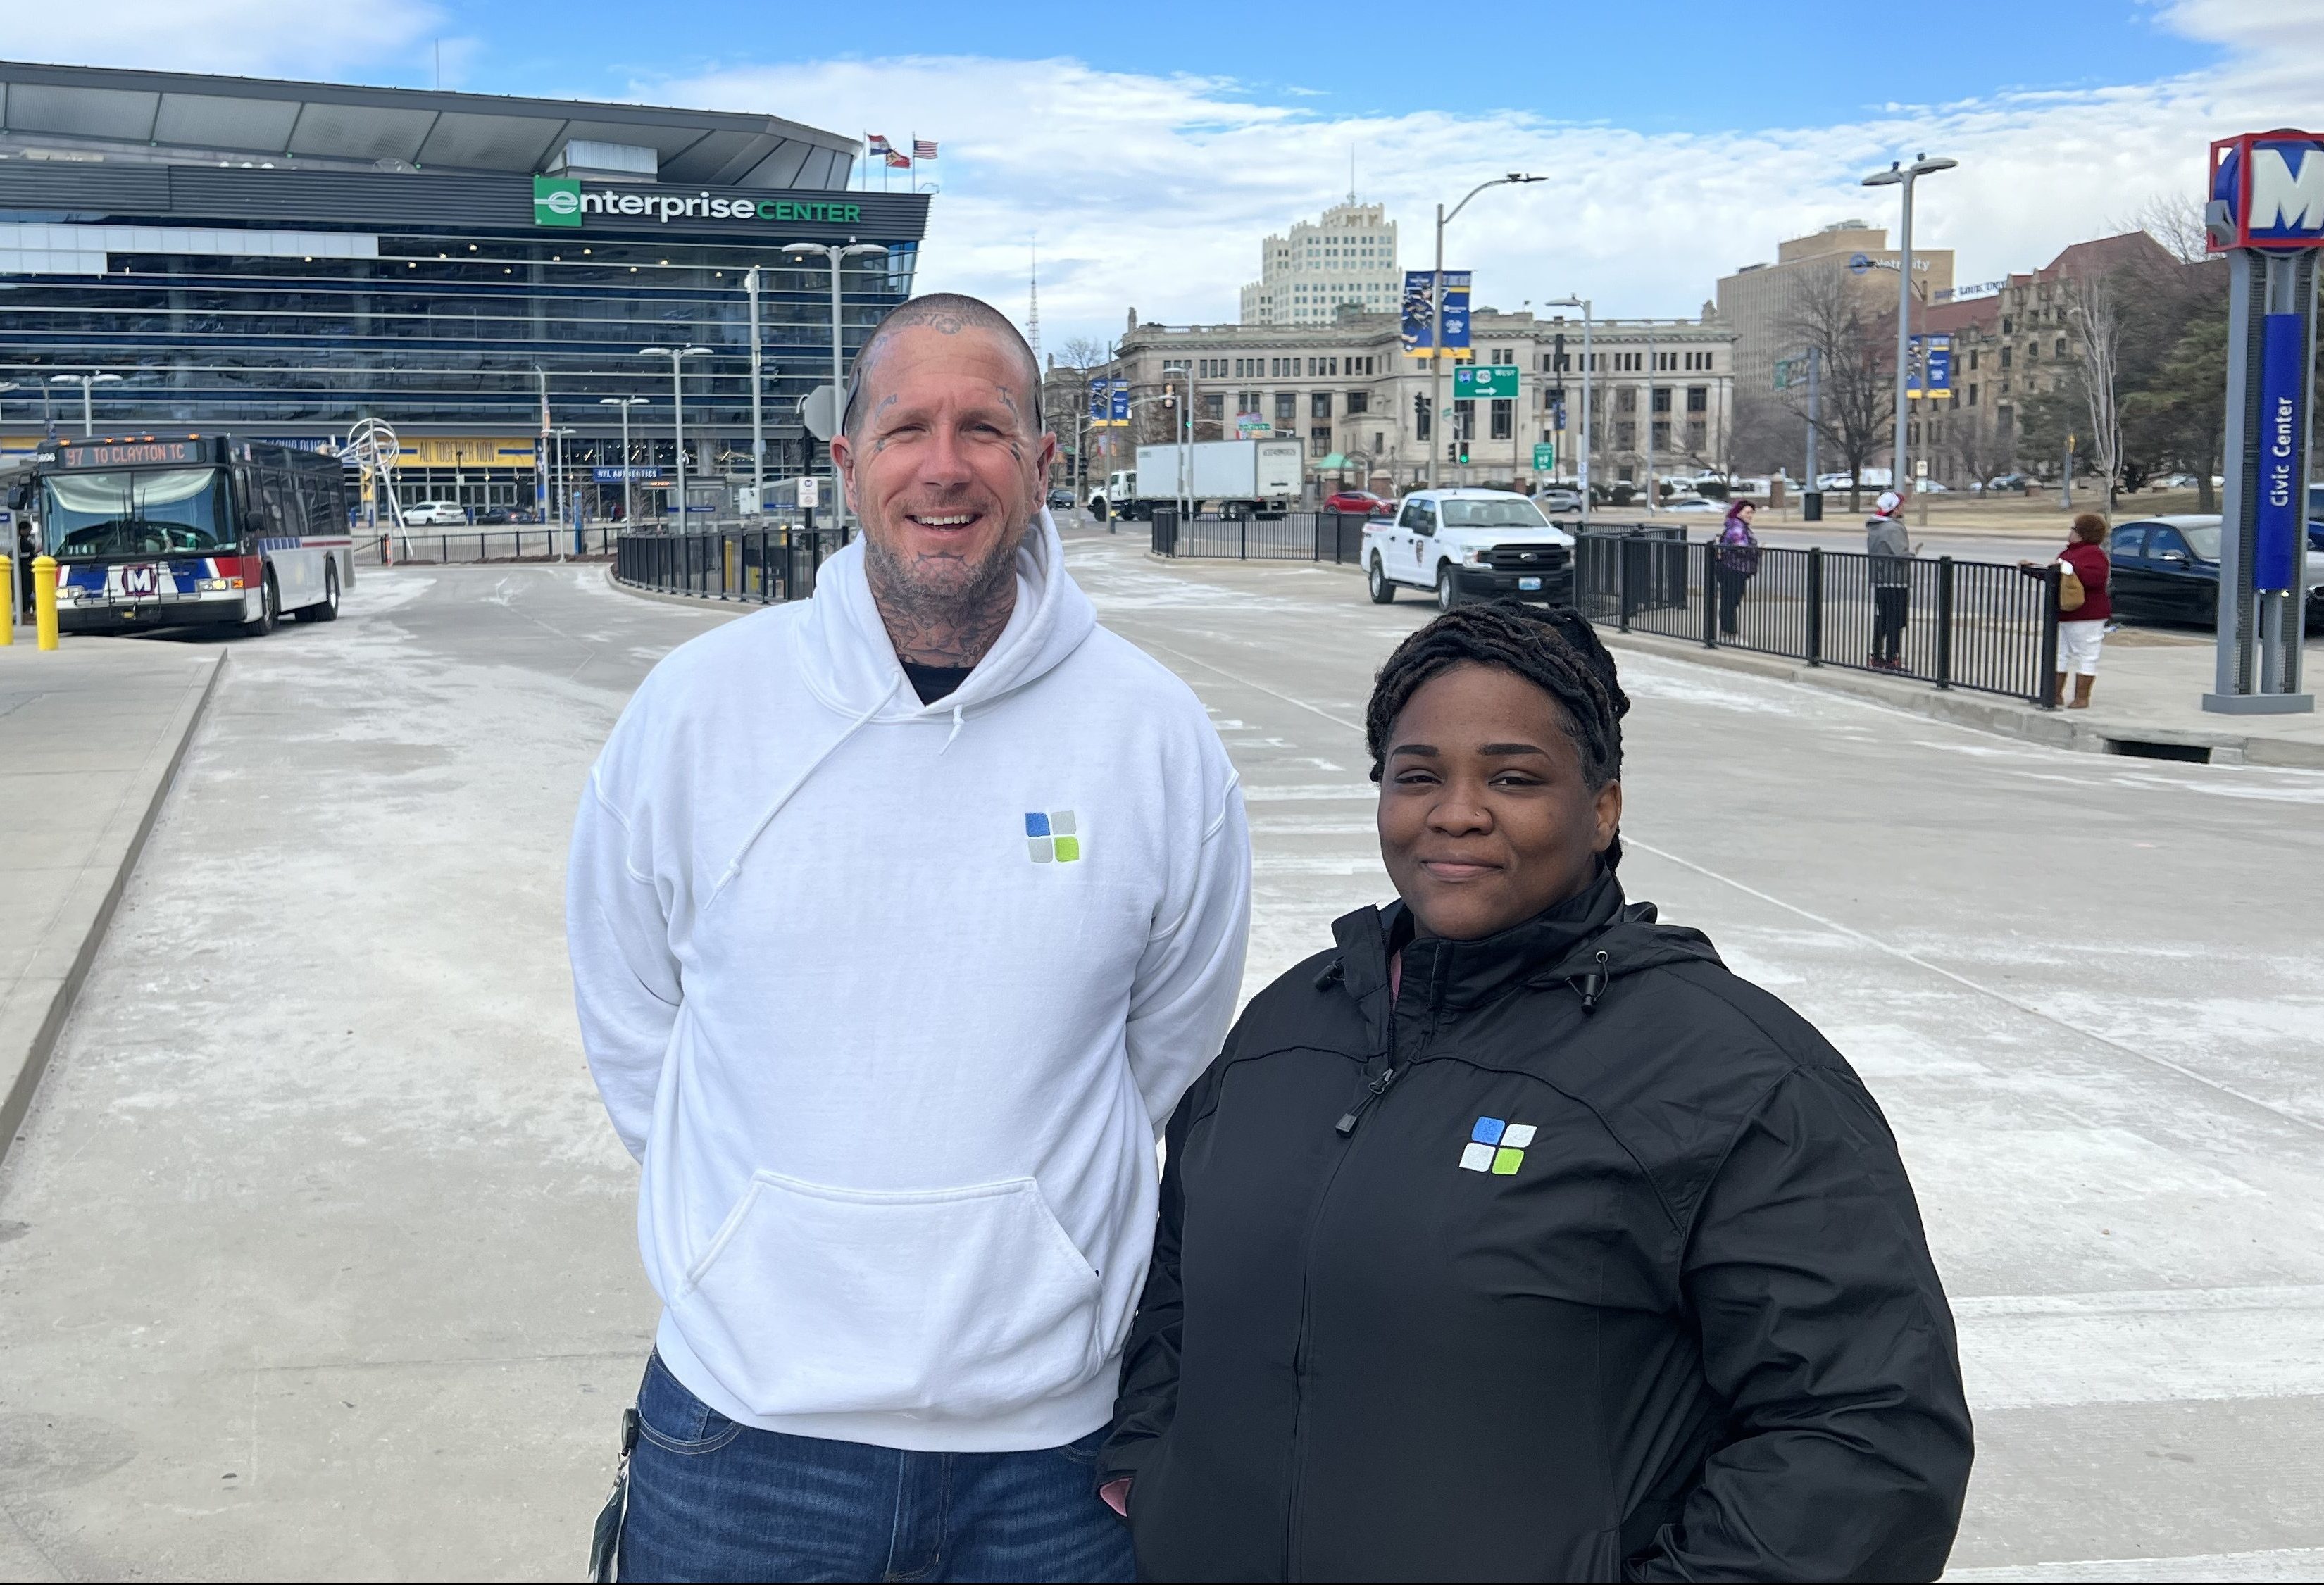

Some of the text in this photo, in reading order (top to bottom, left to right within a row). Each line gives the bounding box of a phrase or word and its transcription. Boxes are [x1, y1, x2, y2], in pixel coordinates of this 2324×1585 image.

[2248, 149, 2324, 230] M
[541, 190, 861, 223] enterprise CENTER
[65, 444, 185, 465] 97 TO CLAYTON TC
[420, 441, 496, 462] ALL TOGETHER NOW
[2269, 396, 2293, 507] Civic Center
[127, 568, 151, 592] M
